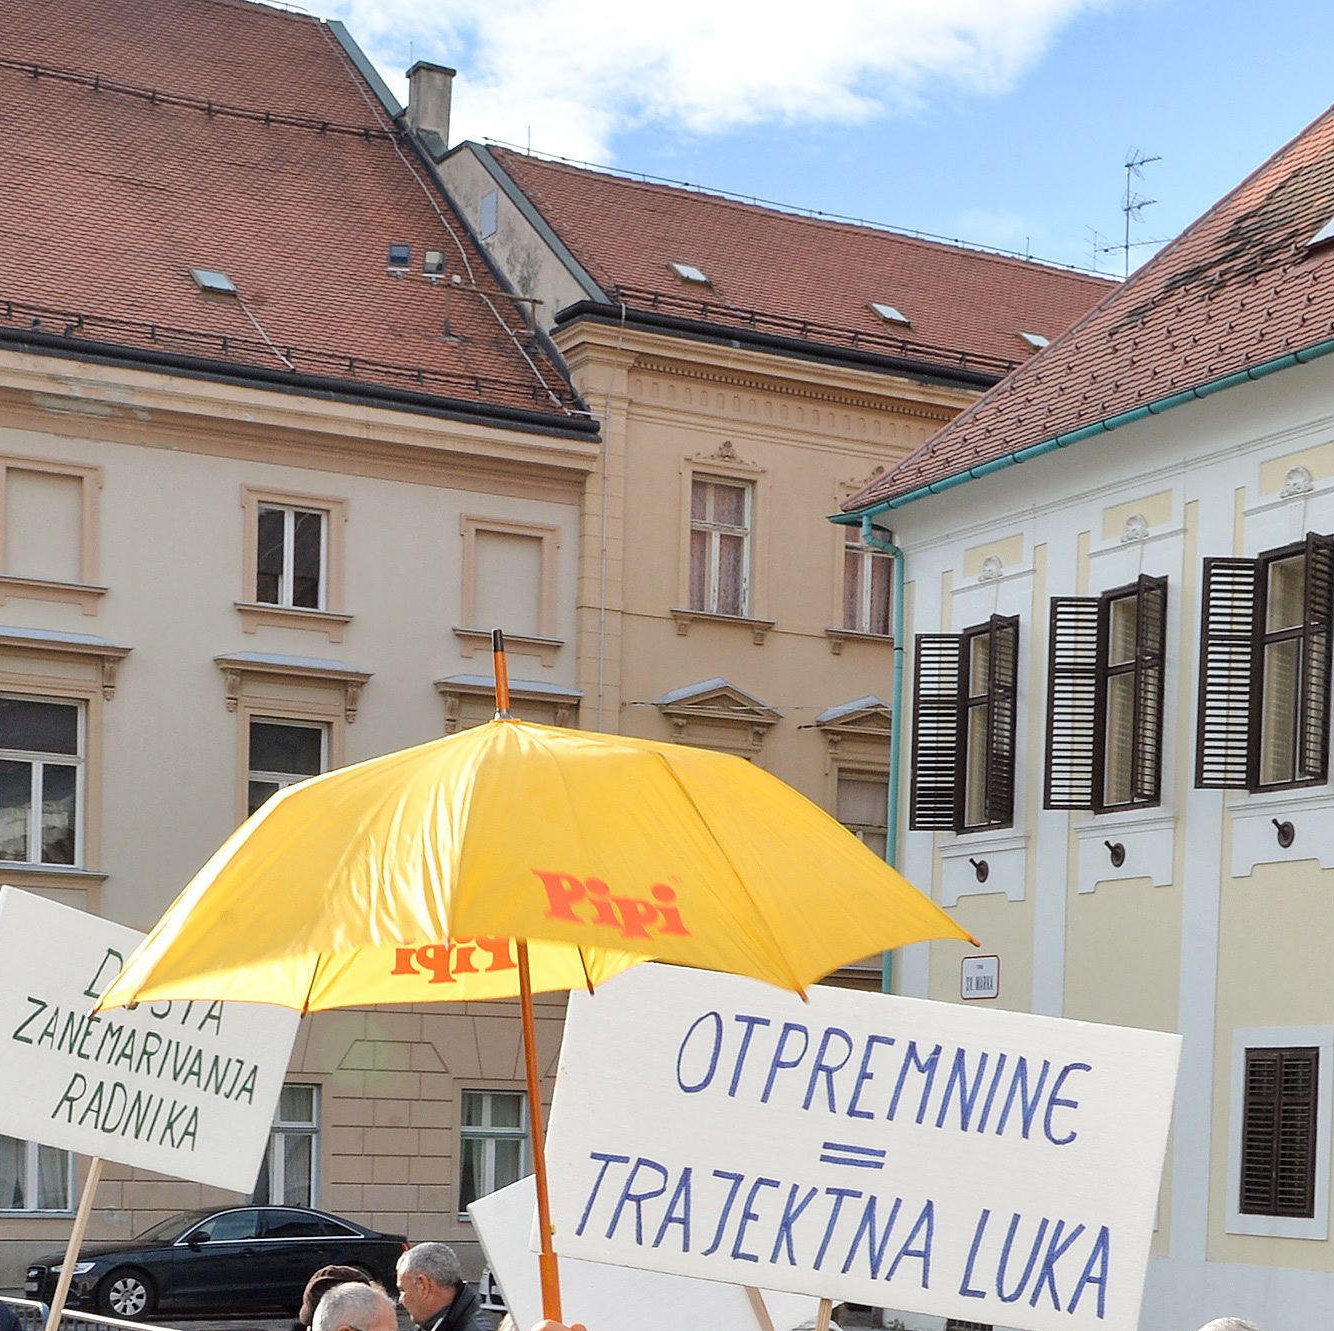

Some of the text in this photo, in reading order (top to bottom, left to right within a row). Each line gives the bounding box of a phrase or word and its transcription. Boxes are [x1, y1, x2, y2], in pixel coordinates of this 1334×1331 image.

[531, 868, 692, 940] Pipi
[12, 996, 259, 1106] ZANEMARIVANJA
[677, 1010, 1092, 1146] OTPREMNINE
[51, 1072, 199, 1152] RADNIKA
[576, 1151, 1111, 1319] TRAJEKTNA LUKA
